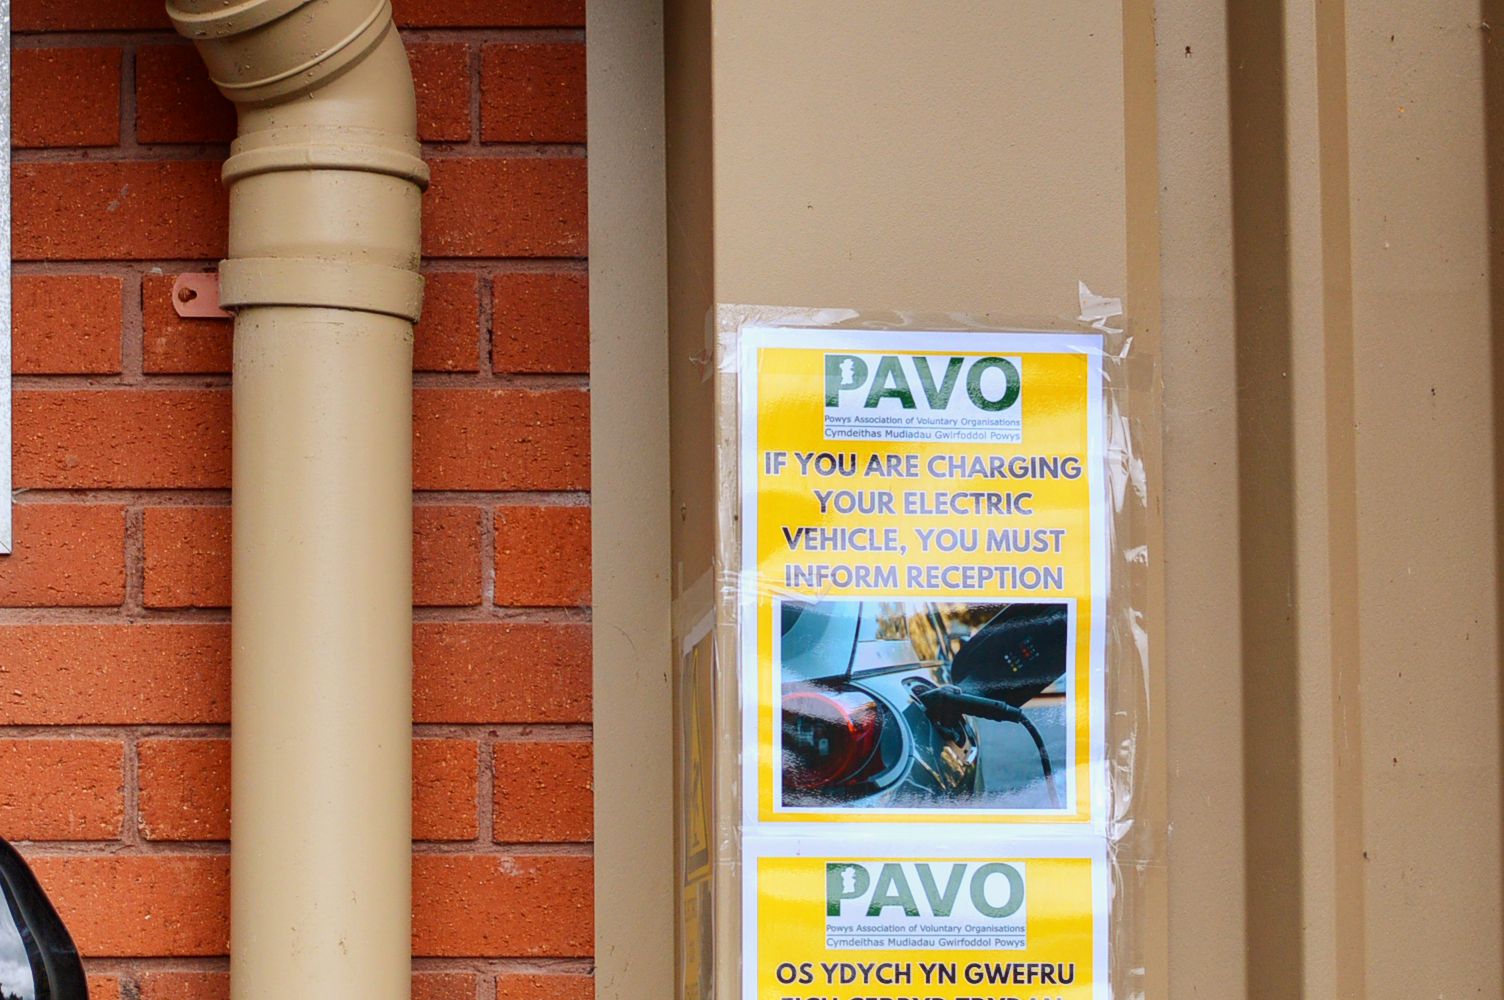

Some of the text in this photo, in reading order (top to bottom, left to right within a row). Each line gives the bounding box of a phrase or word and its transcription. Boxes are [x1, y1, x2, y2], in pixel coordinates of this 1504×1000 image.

[824, 354, 1021, 411] PAVO
[824, 415, 1021, 427] Powys Association of Voluntary Organisations
[824, 428, 1021, 441] Cymdeithas Mudiadau Gwirfoddol Powys
[764, 452, 1082, 480] IF YOU ARE CHARGING
[813, 490, 1033, 516] YOUR ELECTRIC
[782, 526, 1066, 555] VEHICLE, YOU MUST
[785, 563, 1064, 590] INFORM RECEPTION
[826, 862, 1025, 918] PAVO
[826, 923, 1025, 934] Powys Association of Voluntary Organisations
[826, 937, 1025, 948] Cymdeithas Mudiadau Gwirfoddol Powys
[776, 962, 1075, 985] OS YDYCH YN GWEFRU
